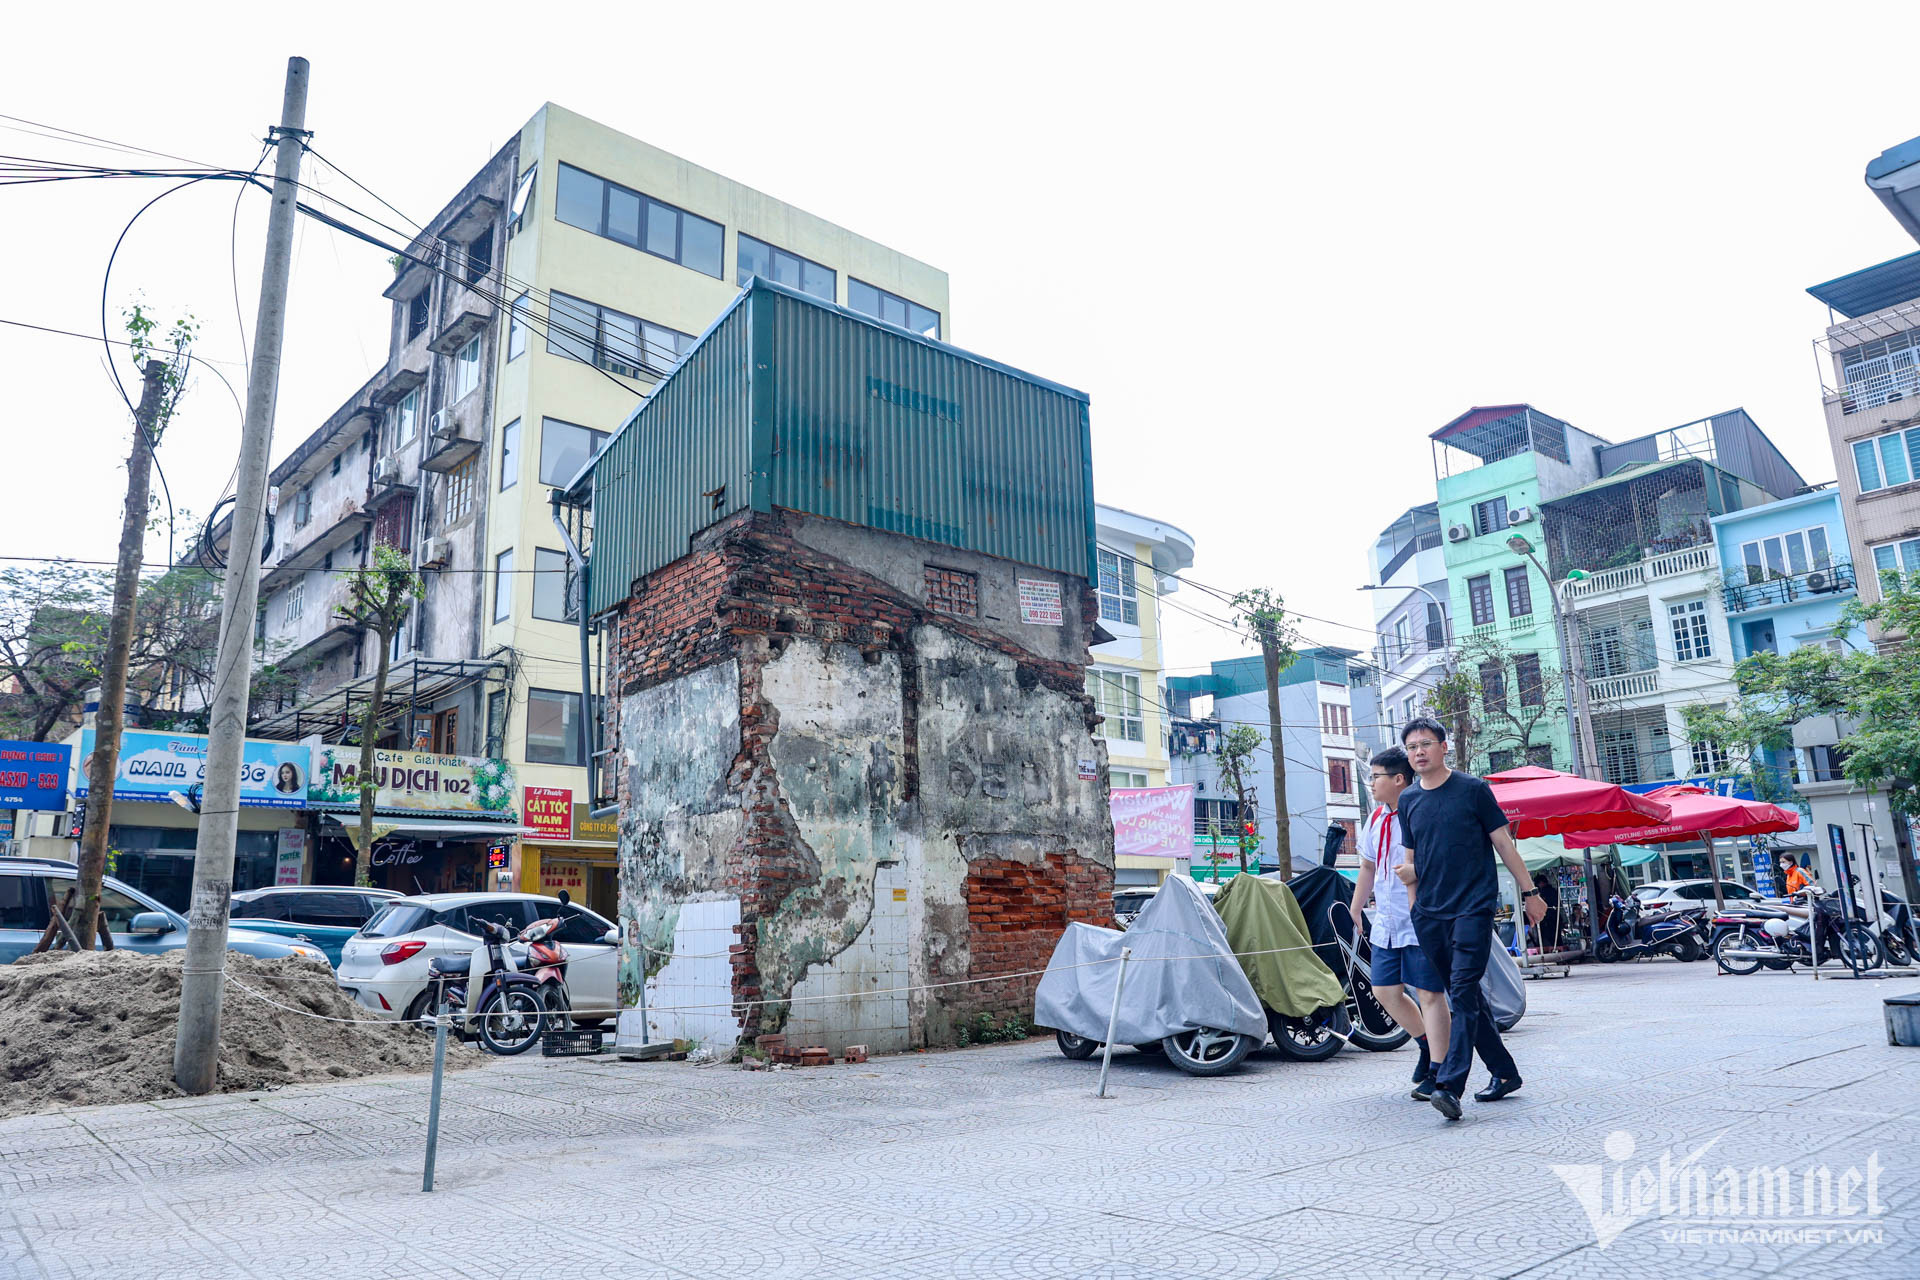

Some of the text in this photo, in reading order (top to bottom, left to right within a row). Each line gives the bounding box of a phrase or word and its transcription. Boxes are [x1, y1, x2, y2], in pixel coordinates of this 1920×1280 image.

[129, 760, 186, 778] NAIL
[38, 772, 58, 789] 533
[332, 763, 470, 794] MU DỊCH 102
[549, 799, 568, 814] TÓC
[533, 814, 562, 825] NAM
[1614, 830, 1644, 841] HOTLINE:
[372, 841, 423, 866] Coffee
